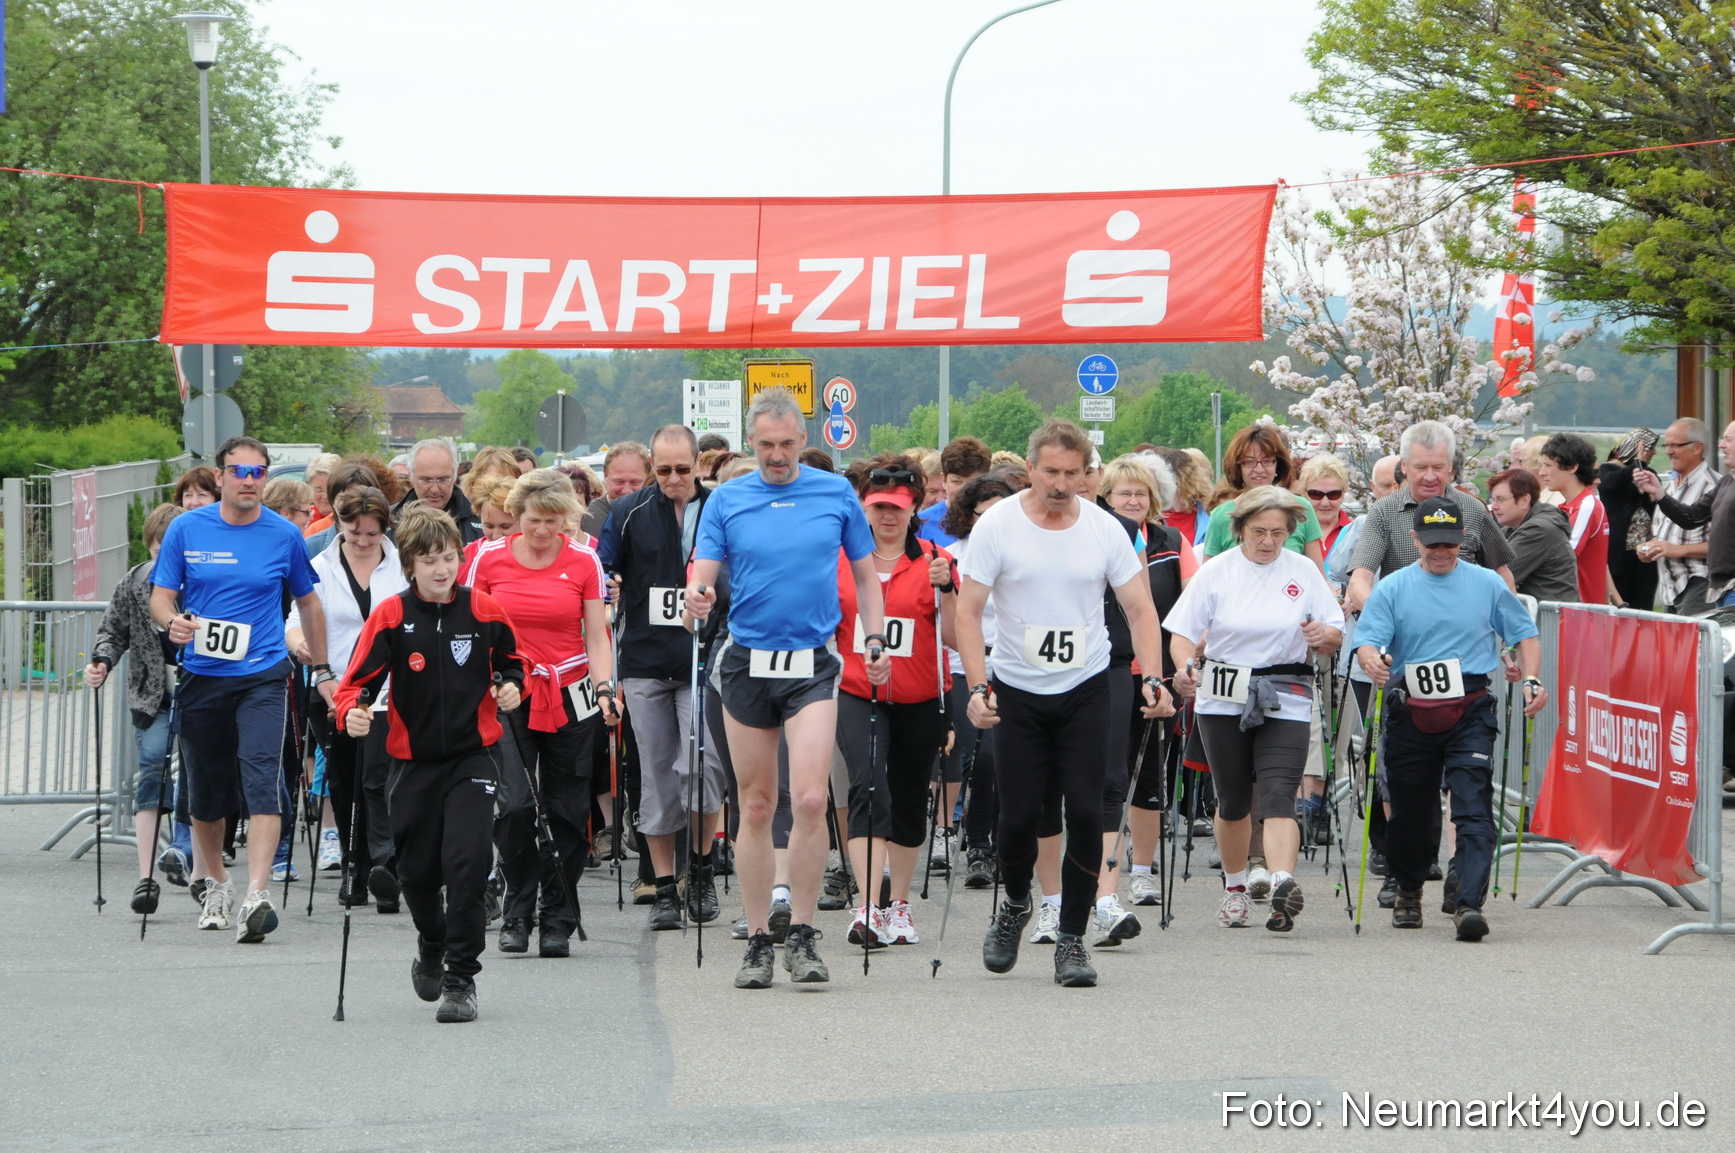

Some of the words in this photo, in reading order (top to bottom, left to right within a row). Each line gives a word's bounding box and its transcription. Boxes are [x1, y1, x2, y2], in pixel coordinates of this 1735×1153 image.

[753, 382, 807, 395] Narkt
[831, 388, 849, 403] 60
[206, 621, 239, 655] 50
[887, 619, 903, 650] 0
[1038, 630, 1074, 664] 45
[1212, 666, 1239, 698] 117
[1416, 662, 1451, 695] 89
[1622, 716, 1636, 767] BEI
[1637, 718, 1658, 772] SEAT
[1669, 771, 1689, 787] SEAT
